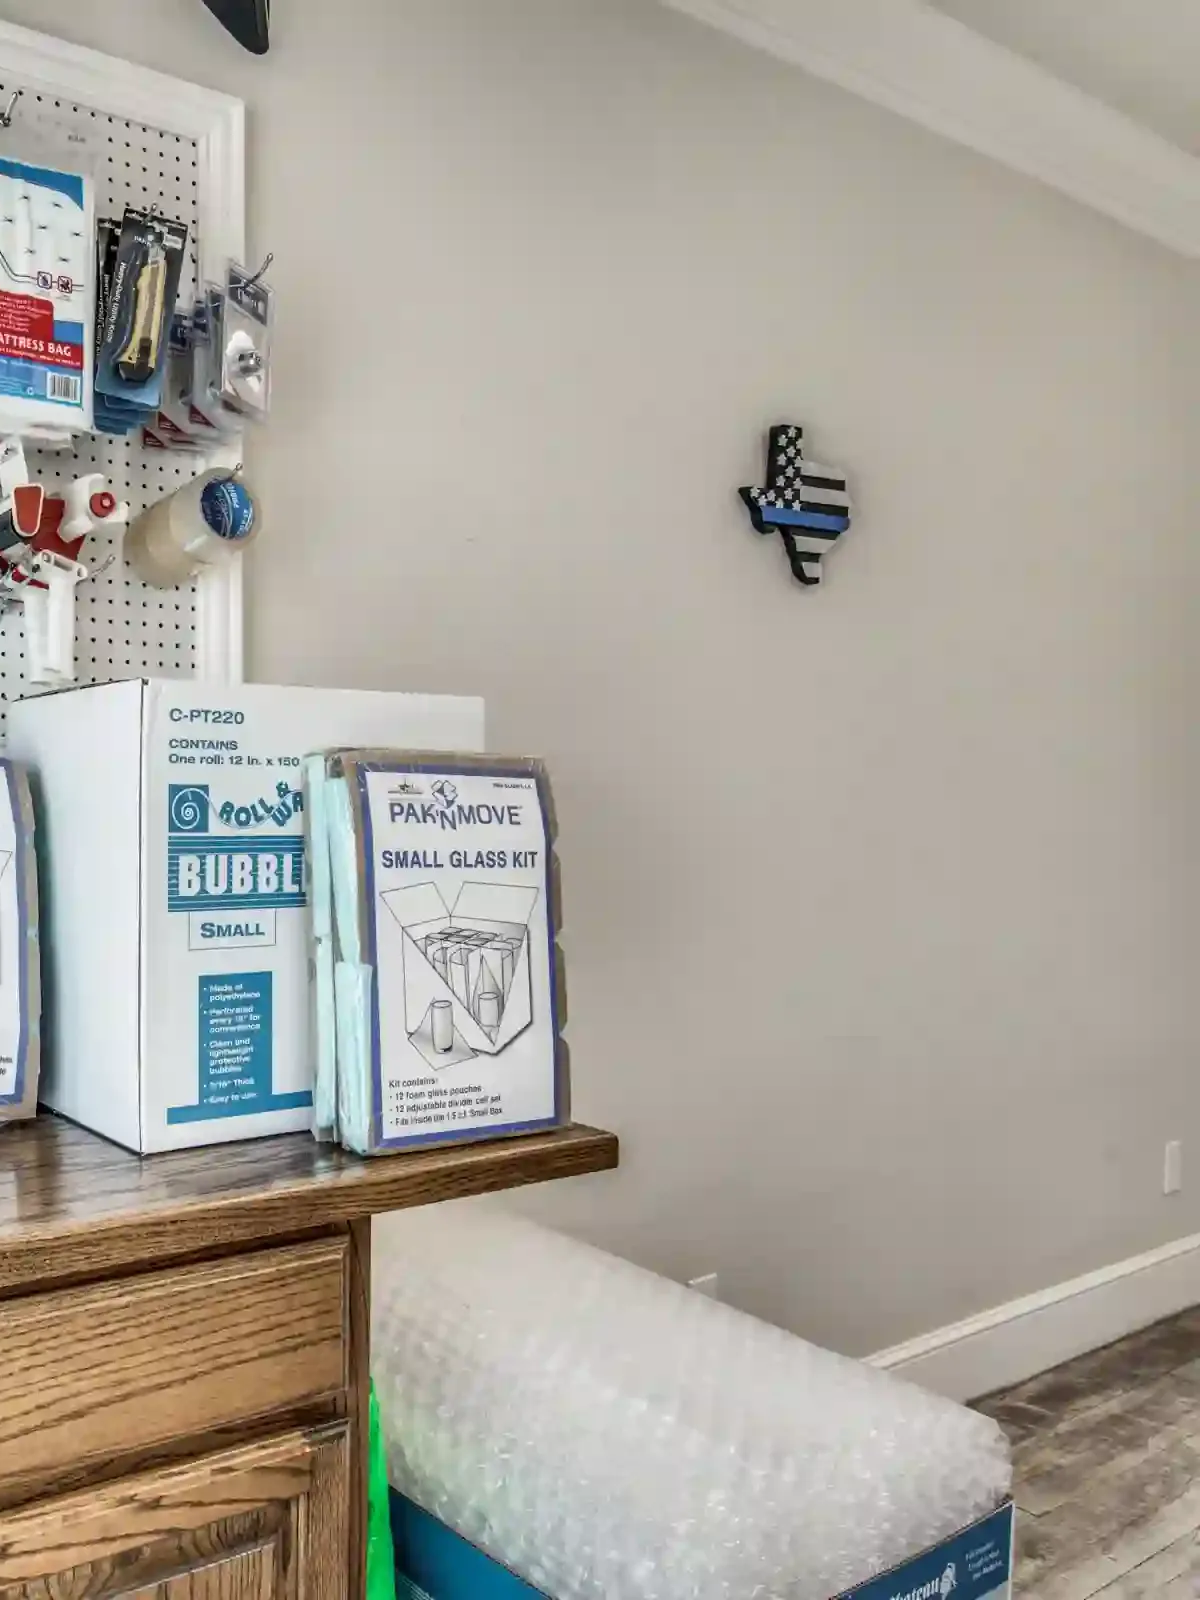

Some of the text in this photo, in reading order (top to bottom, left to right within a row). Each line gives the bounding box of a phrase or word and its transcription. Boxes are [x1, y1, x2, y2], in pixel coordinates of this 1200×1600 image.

[47, 342, 71, 357] BAG
[169, 708, 245, 725] C-PT220
[168, 738, 239, 751] CONTAINS
[168, 753, 196, 765] One
[200, 754, 224, 765] roll:
[228, 755, 243, 766] 12
[278, 756, 300, 767] 150
[219, 798, 275, 827] ROLL
[381, 850, 539, 869] SMALL GLASS KIT
[178, 853, 304, 896] BUBBL
[200, 922, 265, 939] SMALL
[388, 1077, 439, 1088] Kit contains:
[395, 1085, 482, 1101] 12 foam glass pouches
[395, 1105, 405, 1114] 12
[406, 1100, 447, 1113] adjustable
